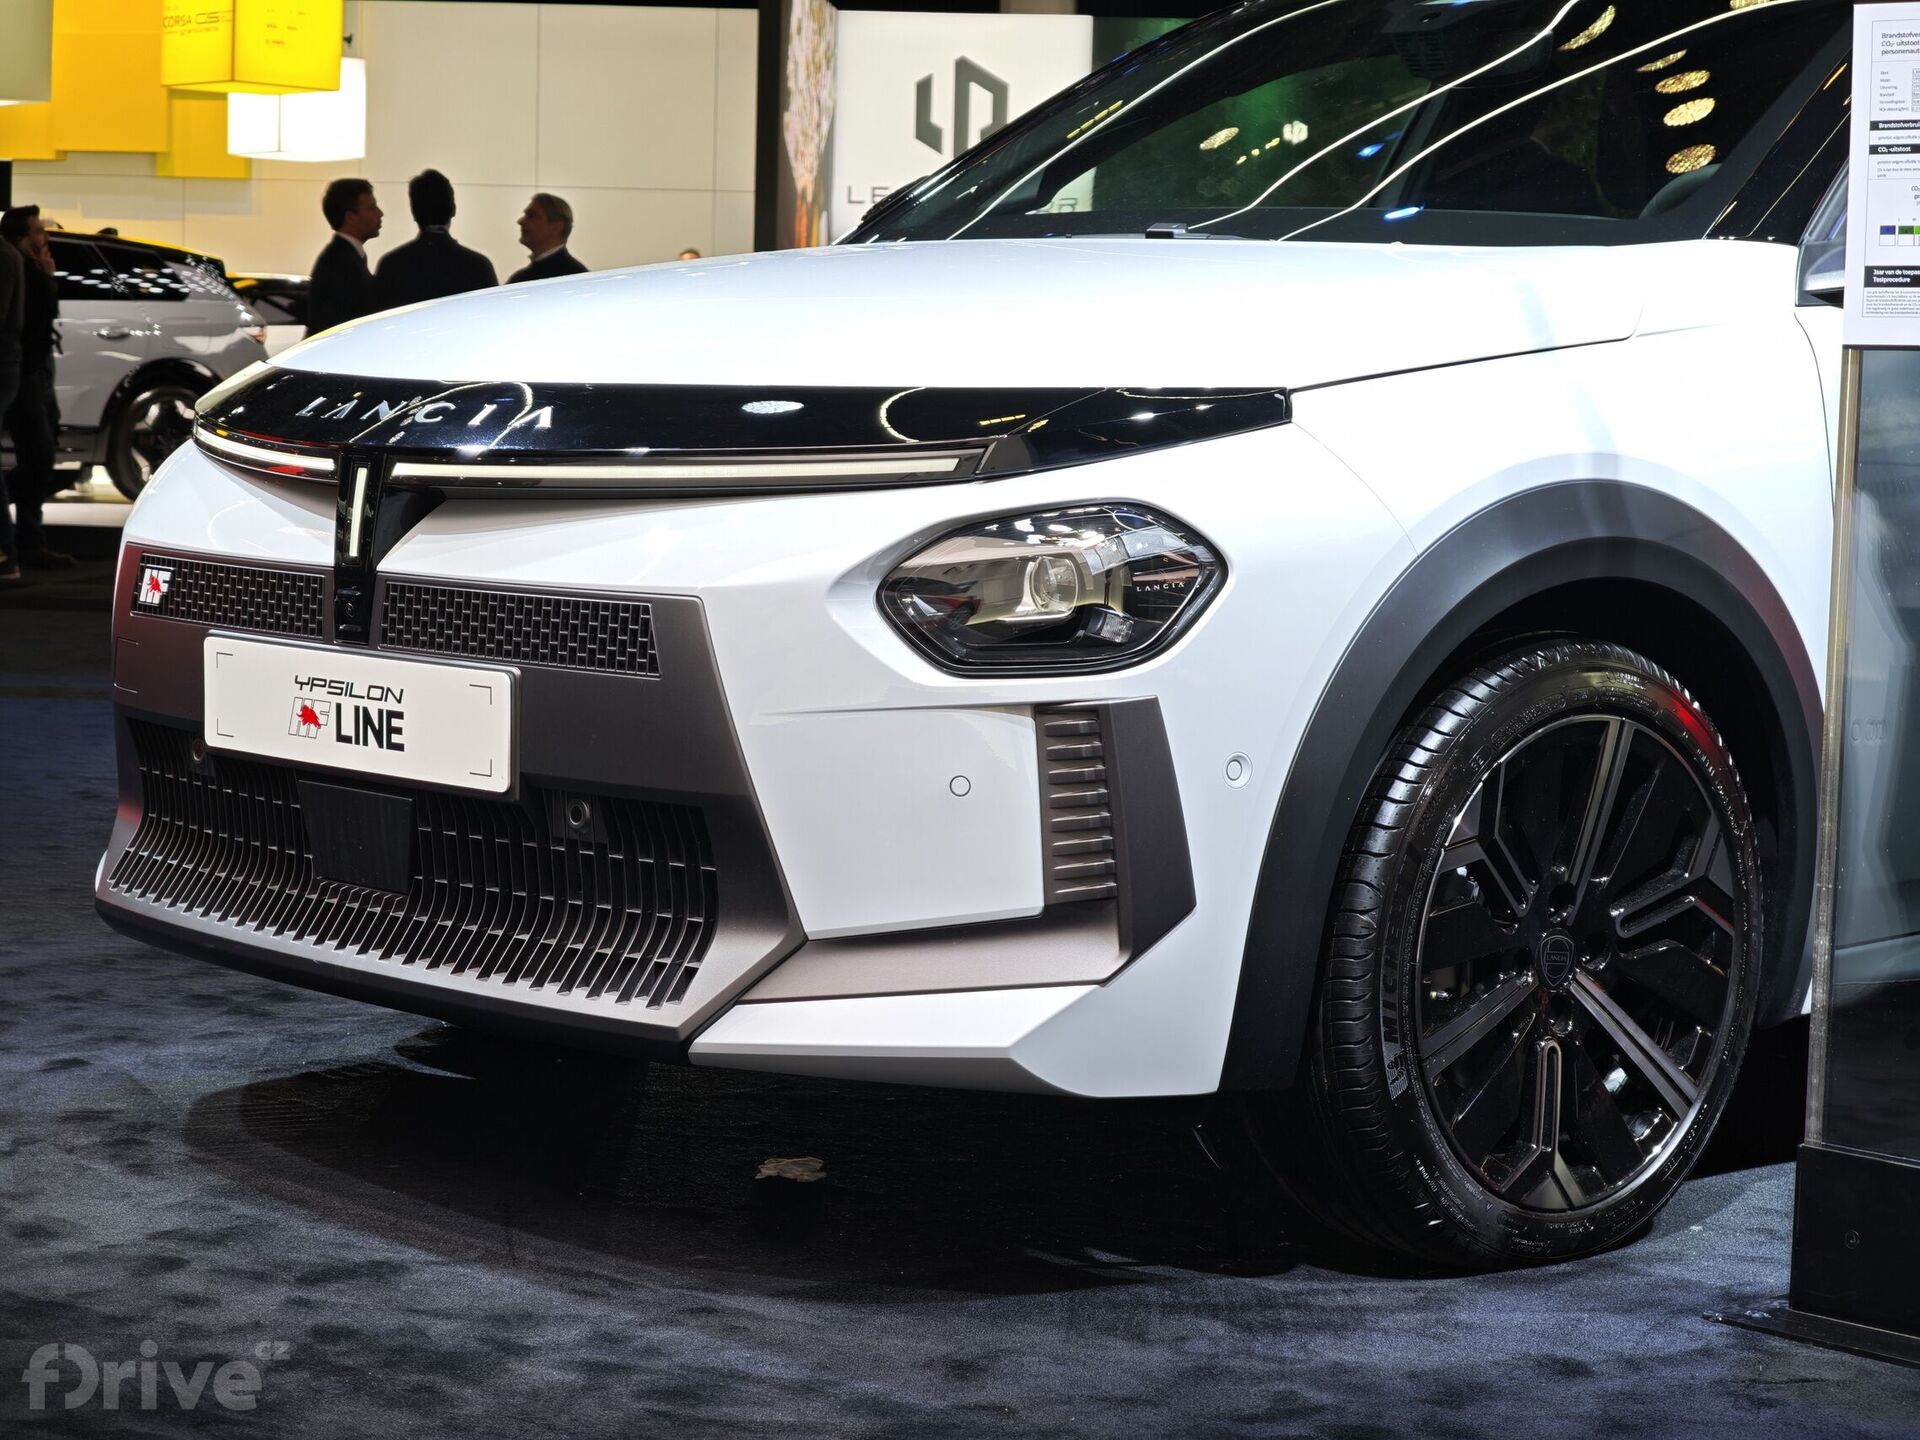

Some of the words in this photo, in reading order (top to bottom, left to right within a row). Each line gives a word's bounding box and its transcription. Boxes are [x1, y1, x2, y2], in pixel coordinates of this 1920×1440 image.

[296, 396, 554, 429] LANCIA
[1136, 582, 1185, 592] LANCIA
[294, 674, 404, 705] YPSILON
[335, 702, 405, 752] LINE
